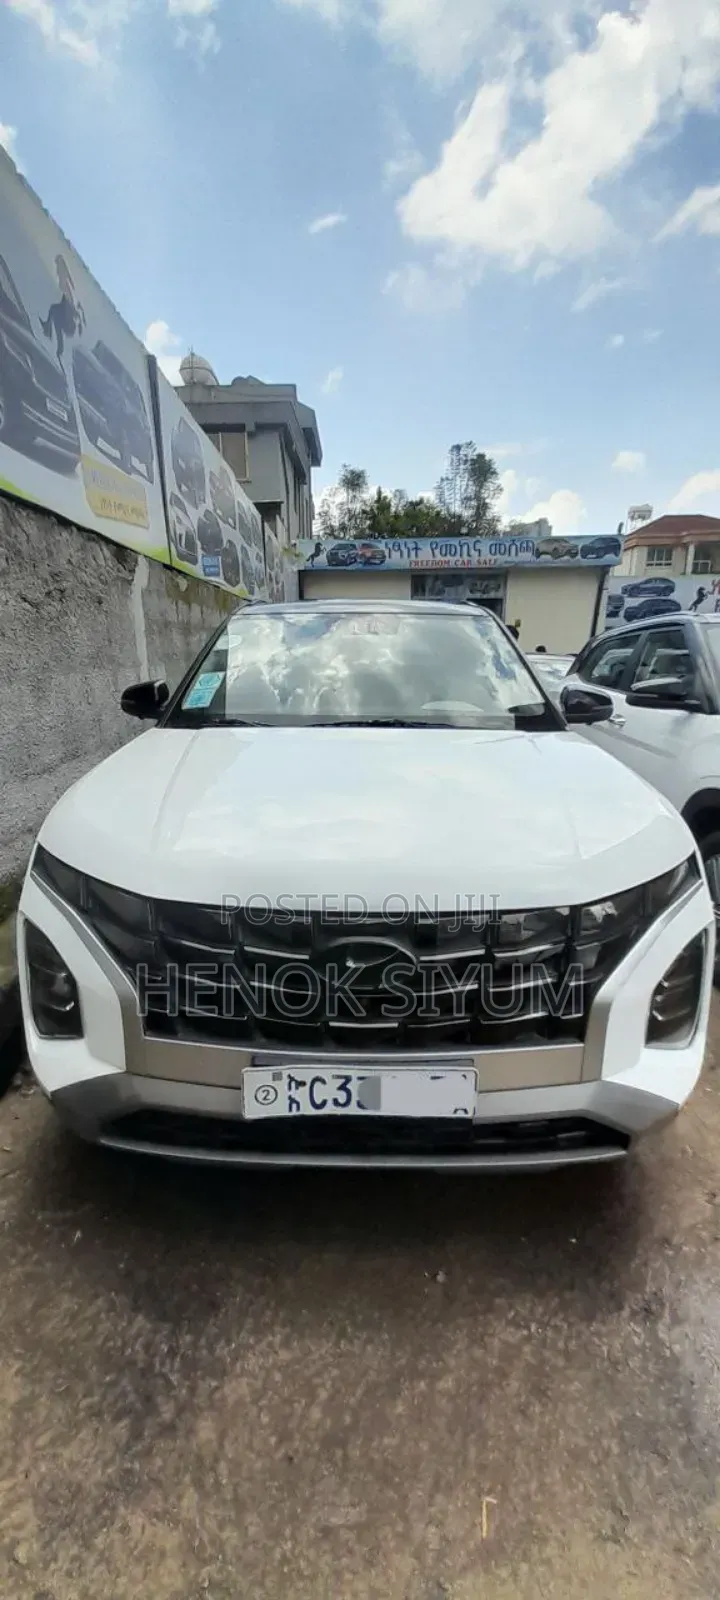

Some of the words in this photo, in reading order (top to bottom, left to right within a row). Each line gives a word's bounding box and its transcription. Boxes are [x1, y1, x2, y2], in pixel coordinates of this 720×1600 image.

[430, 540, 481, 558] የመኪና
[489, 539, 535, 557] መሸጫ
[409, 559, 450, 568] FREEDOM
[455, 559, 471, 568] CAR
[477, 558, 498, 567] SALE
